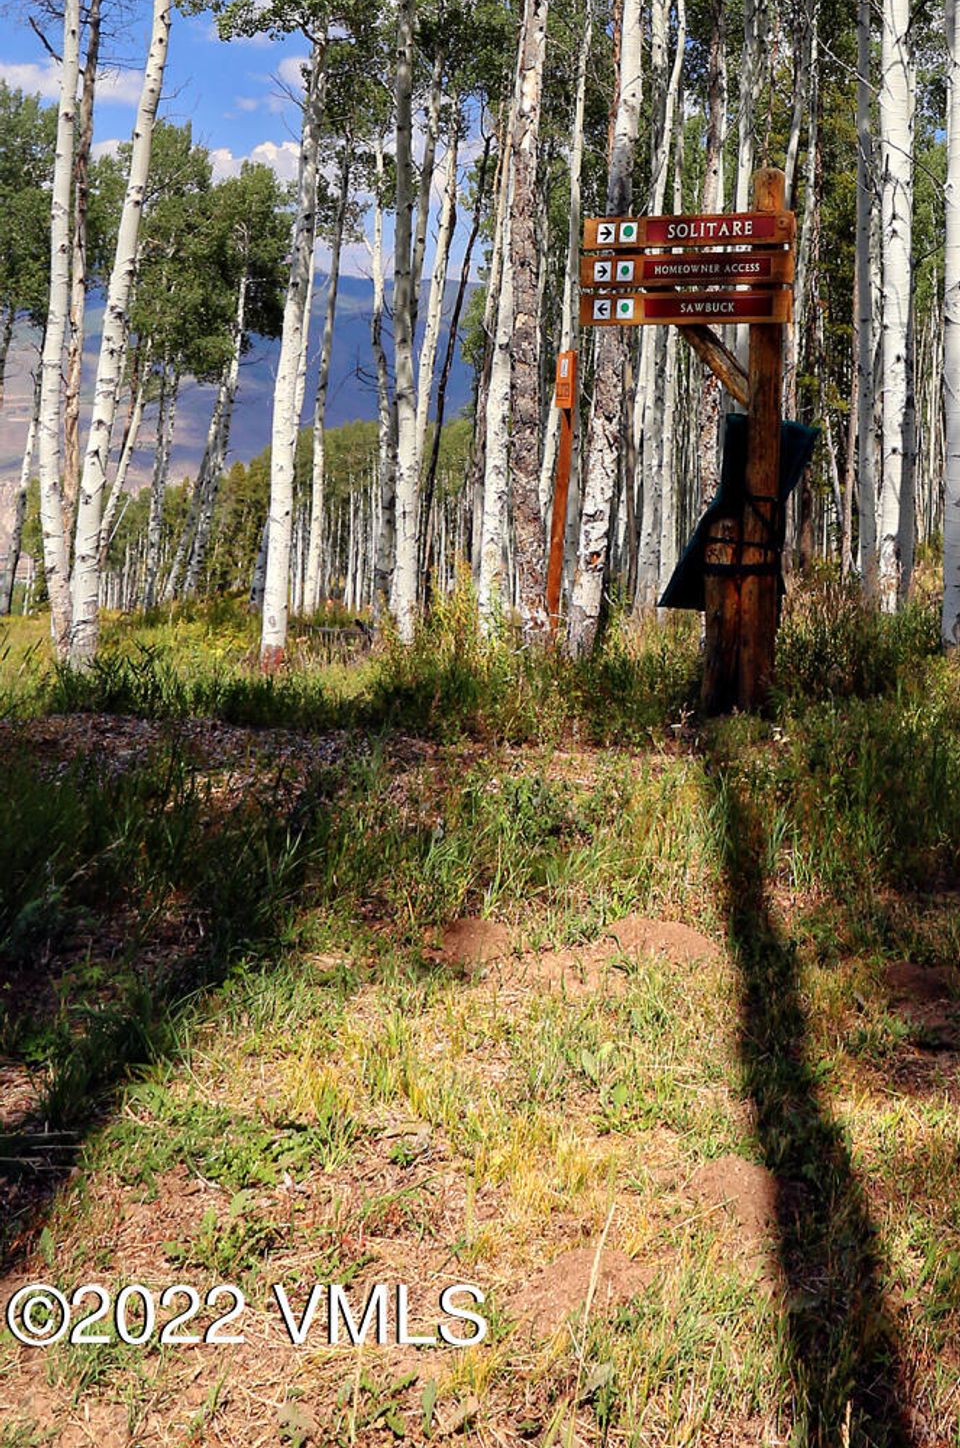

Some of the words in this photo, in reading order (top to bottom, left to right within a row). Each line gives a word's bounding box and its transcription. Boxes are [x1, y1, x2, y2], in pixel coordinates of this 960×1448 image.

[667, 221, 752, 239] SOLITARE
[654, 264, 720, 275] HOMEOWNER
[724, 263, 760, 272] ACCESS
[680, 303, 734, 313] SAWBUCK
